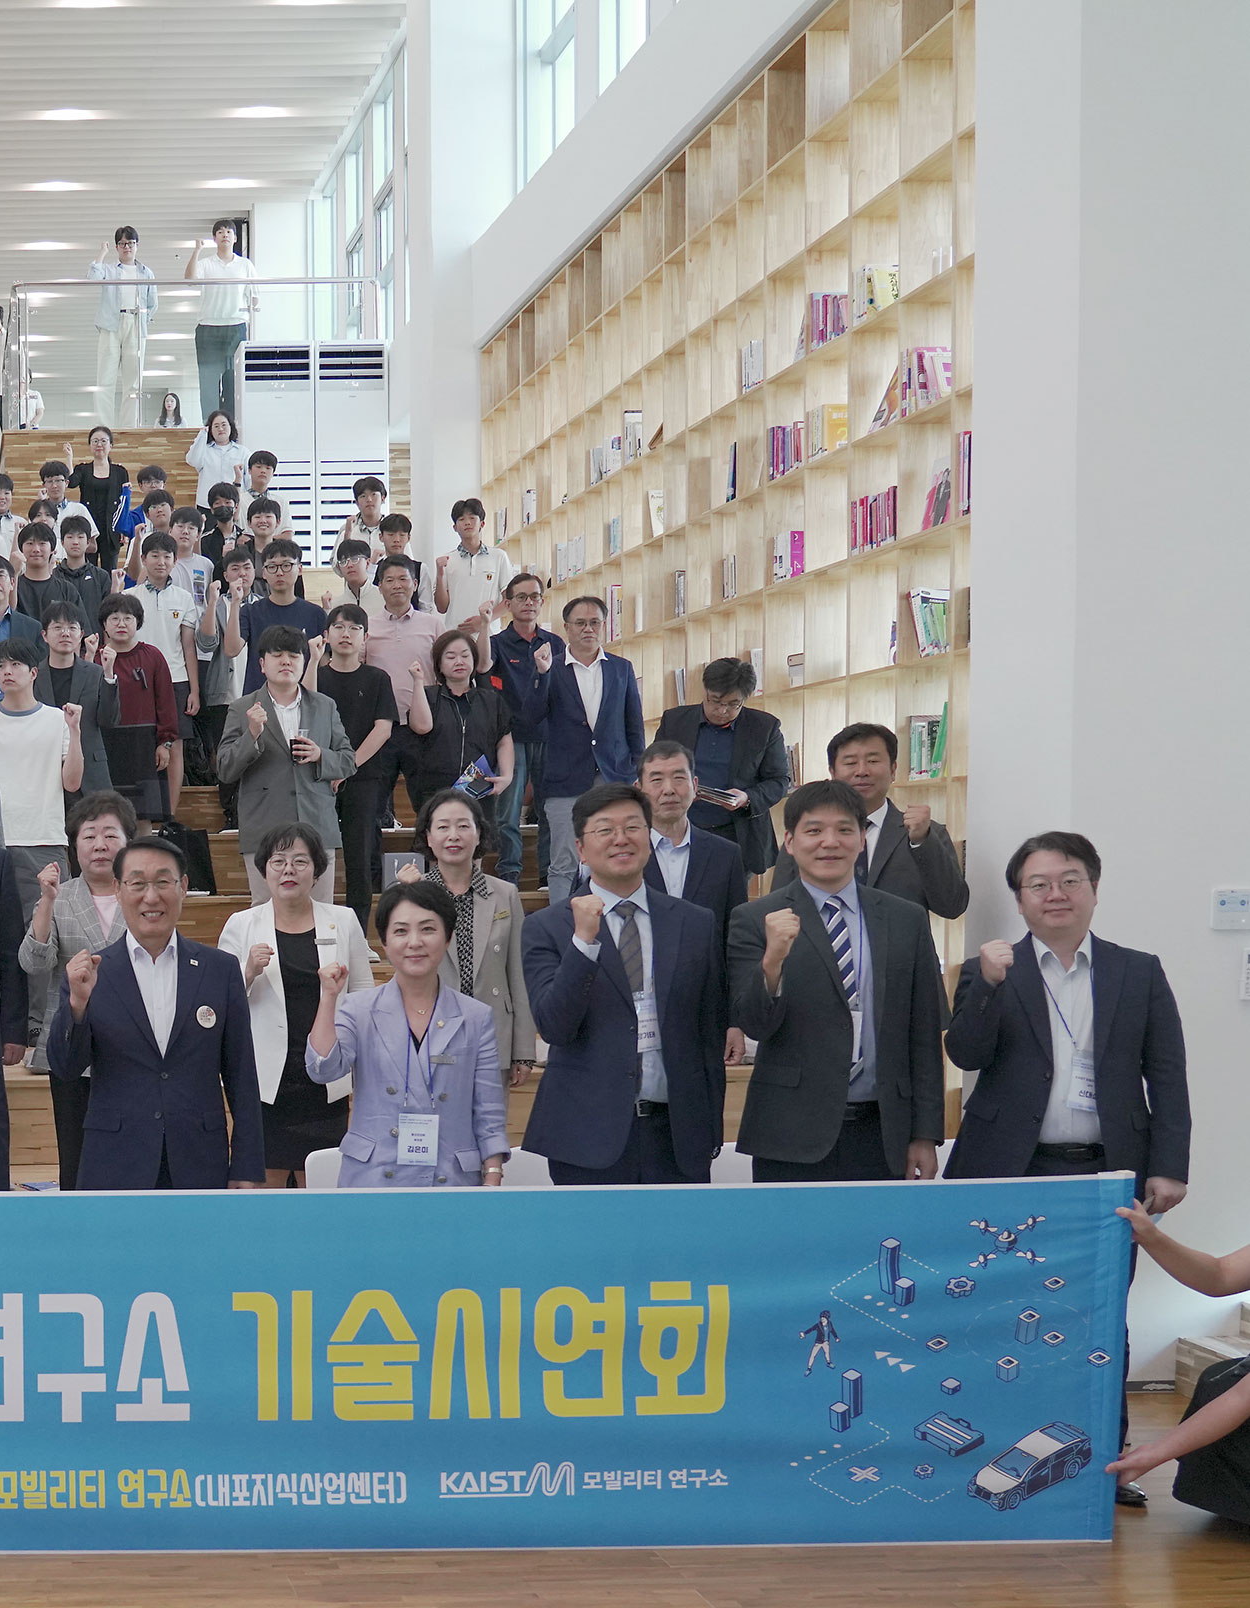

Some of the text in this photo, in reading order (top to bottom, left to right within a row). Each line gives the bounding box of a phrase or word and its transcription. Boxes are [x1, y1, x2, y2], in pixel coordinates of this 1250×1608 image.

[407, 1145, 429, 1154] 김은미
[232, 1281, 730, 1422] 기술시연회
[582, 1469, 662, 1491] 모빌리티
[668, 1468, 729, 1489] 연구소
